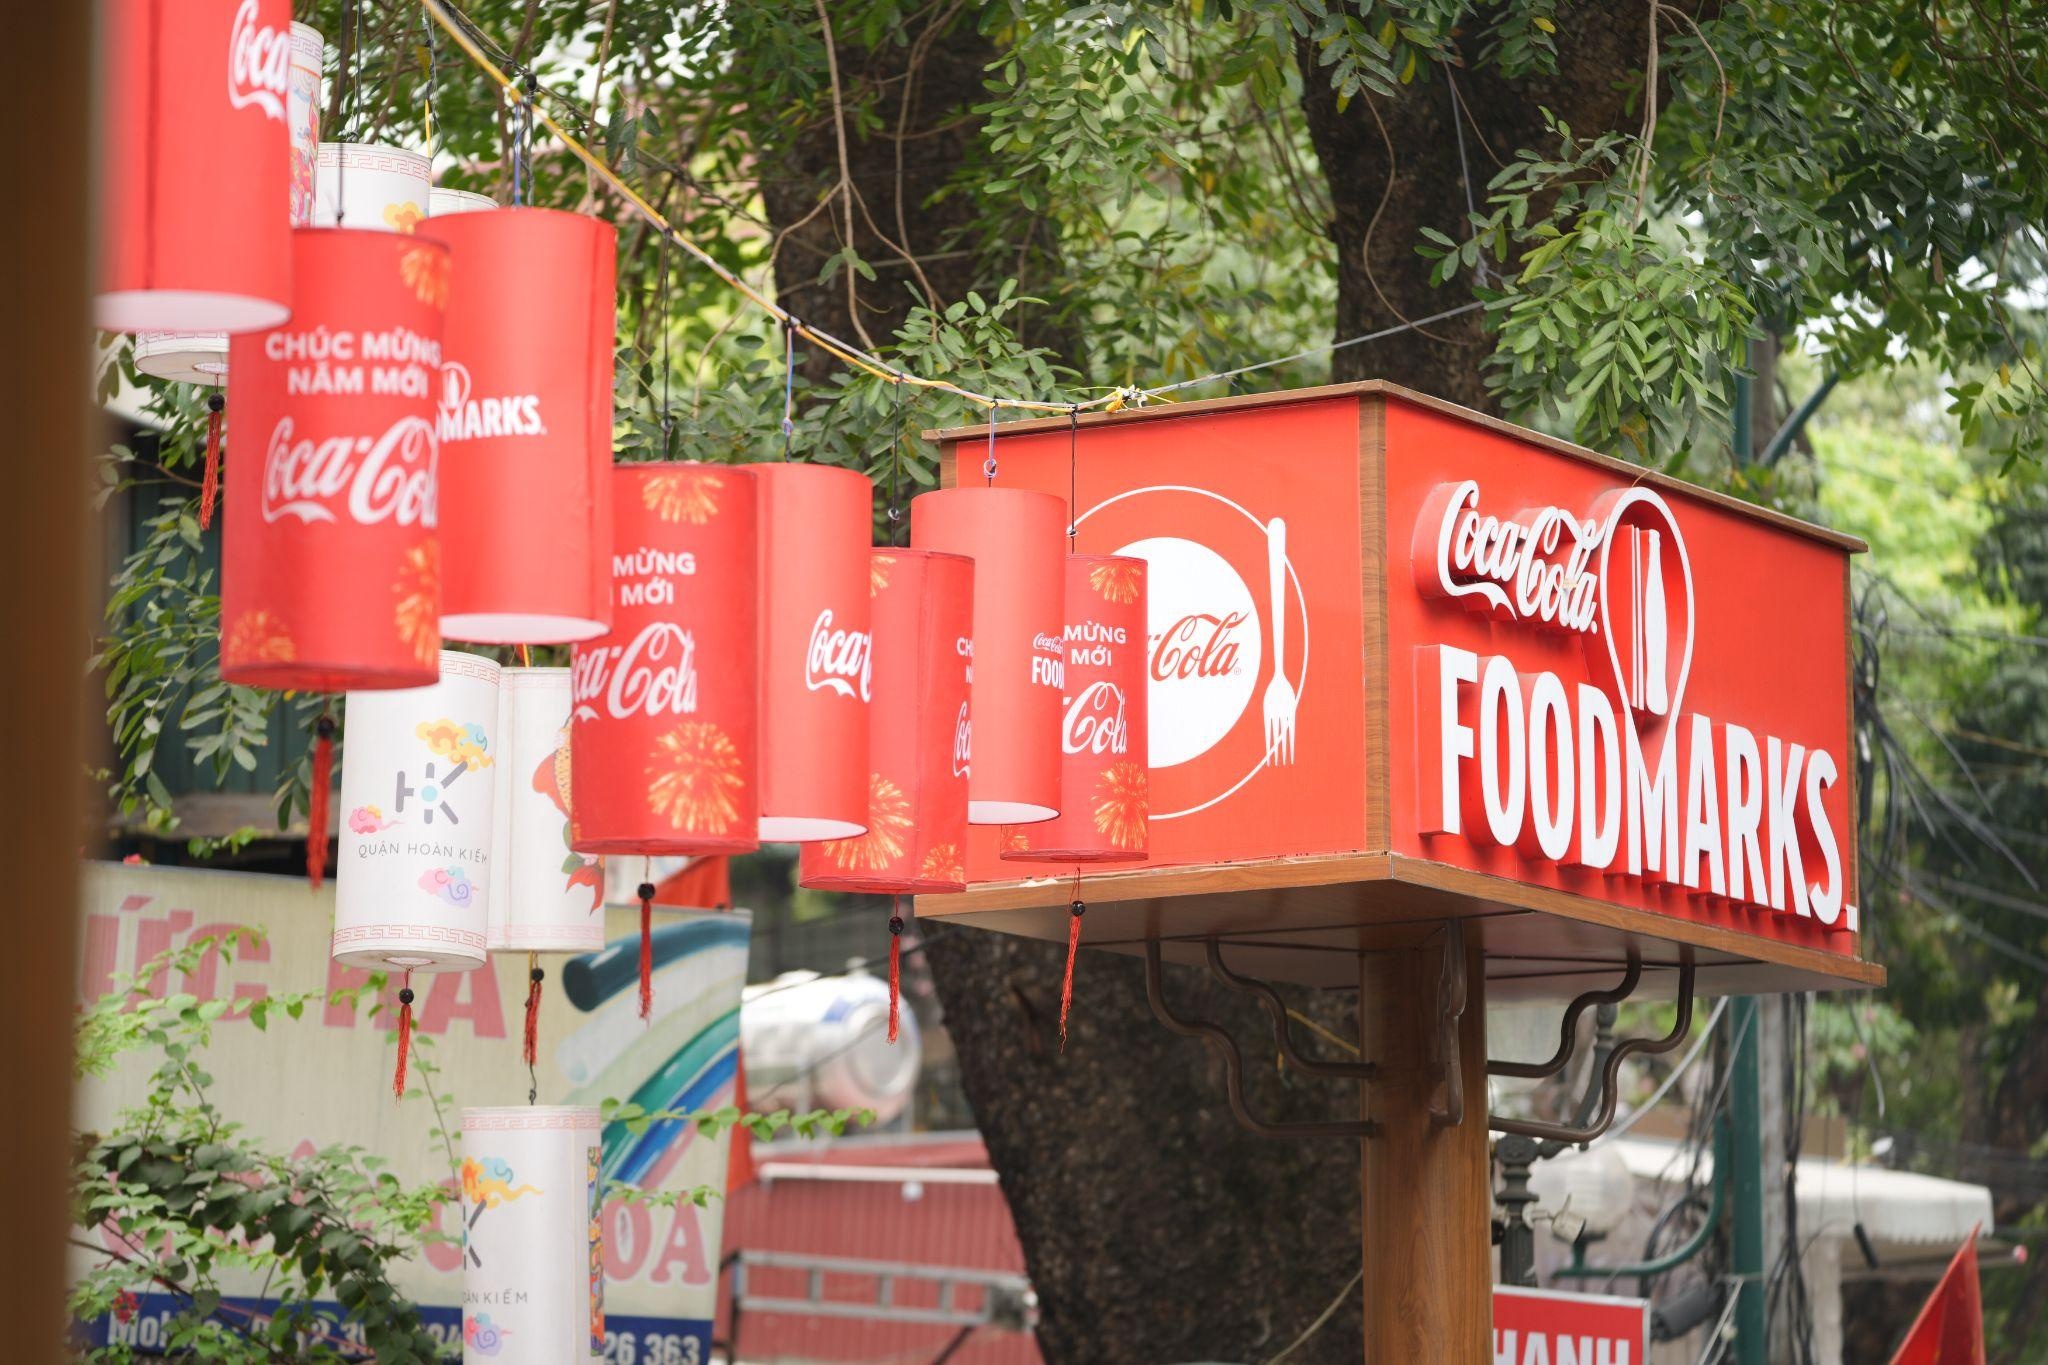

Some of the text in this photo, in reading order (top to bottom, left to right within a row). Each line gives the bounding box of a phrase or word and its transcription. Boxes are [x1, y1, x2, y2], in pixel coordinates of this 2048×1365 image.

[264, 325, 354, 362] CHÚC
[287, 361, 364, 396] NĂM
[613, 546, 696, 577] MỪNG
[621, 576, 675, 607] MỚI
[1064, 621, 1127, 644] MỪNG
[1071, 645, 1112, 667] MỚI
[358, 840, 400, 859] QUẬN
[407, 842, 453, 858] HOÀN
[483, 1287, 528, 1305] KIẾM
